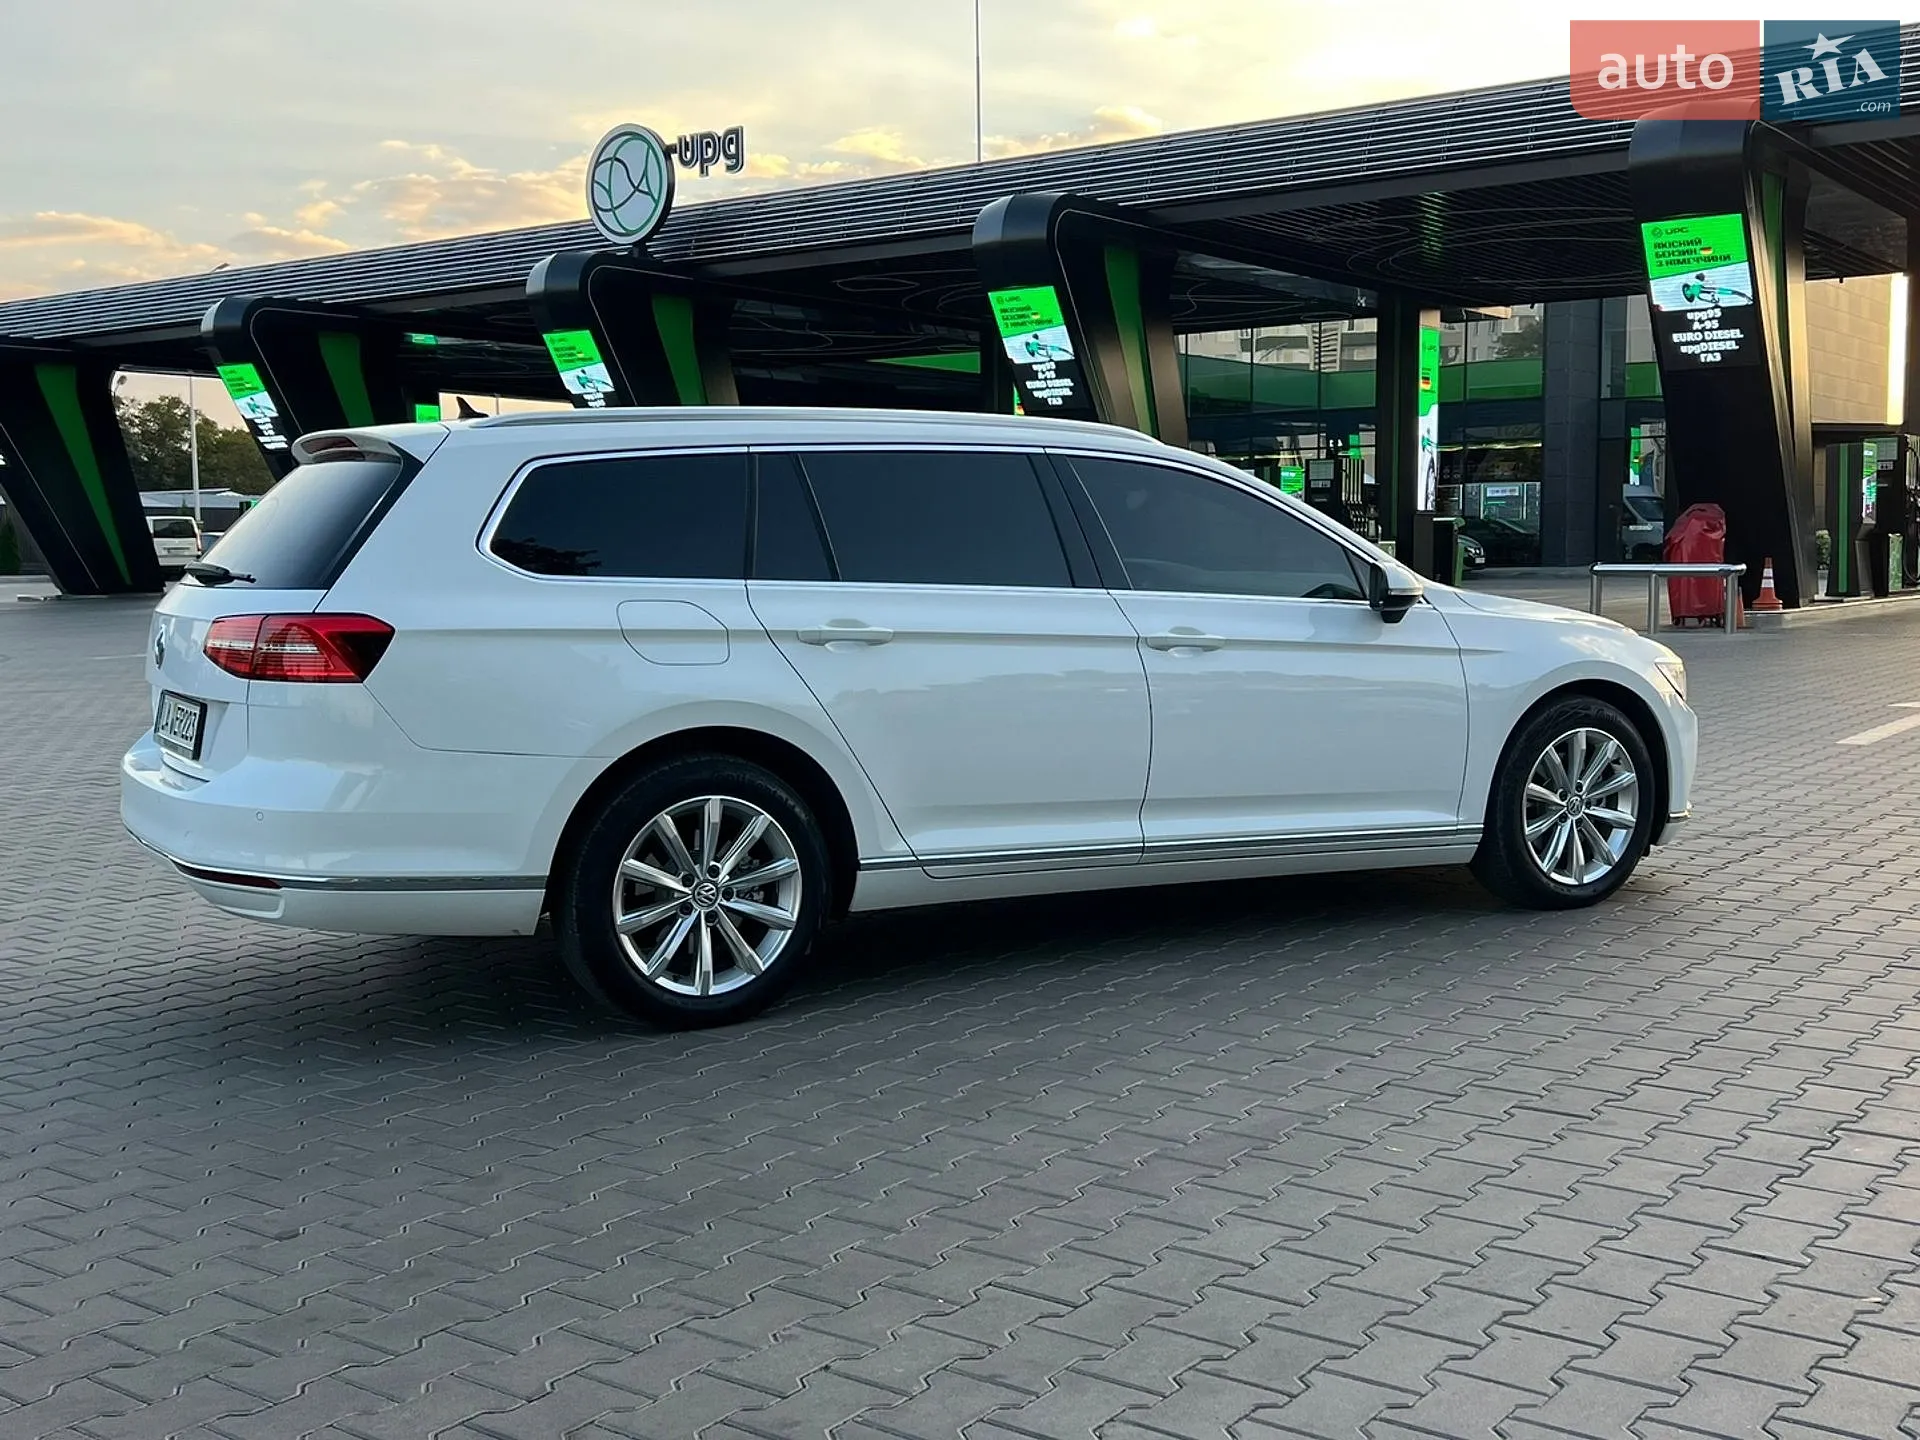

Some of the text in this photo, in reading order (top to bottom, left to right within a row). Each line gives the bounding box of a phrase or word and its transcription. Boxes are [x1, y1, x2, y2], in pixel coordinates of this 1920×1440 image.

[677, 125, 744, 178] upg
[1655, 248, 1697, 259] БЕНЗИН
[1687, 308, 1721, 320] upg95
[1672, 328, 1744, 342] EURO DIESEL
[1680, 340, 1739, 354] upgDIESEL
[1700, 352, 1721, 362] ГАЗ
